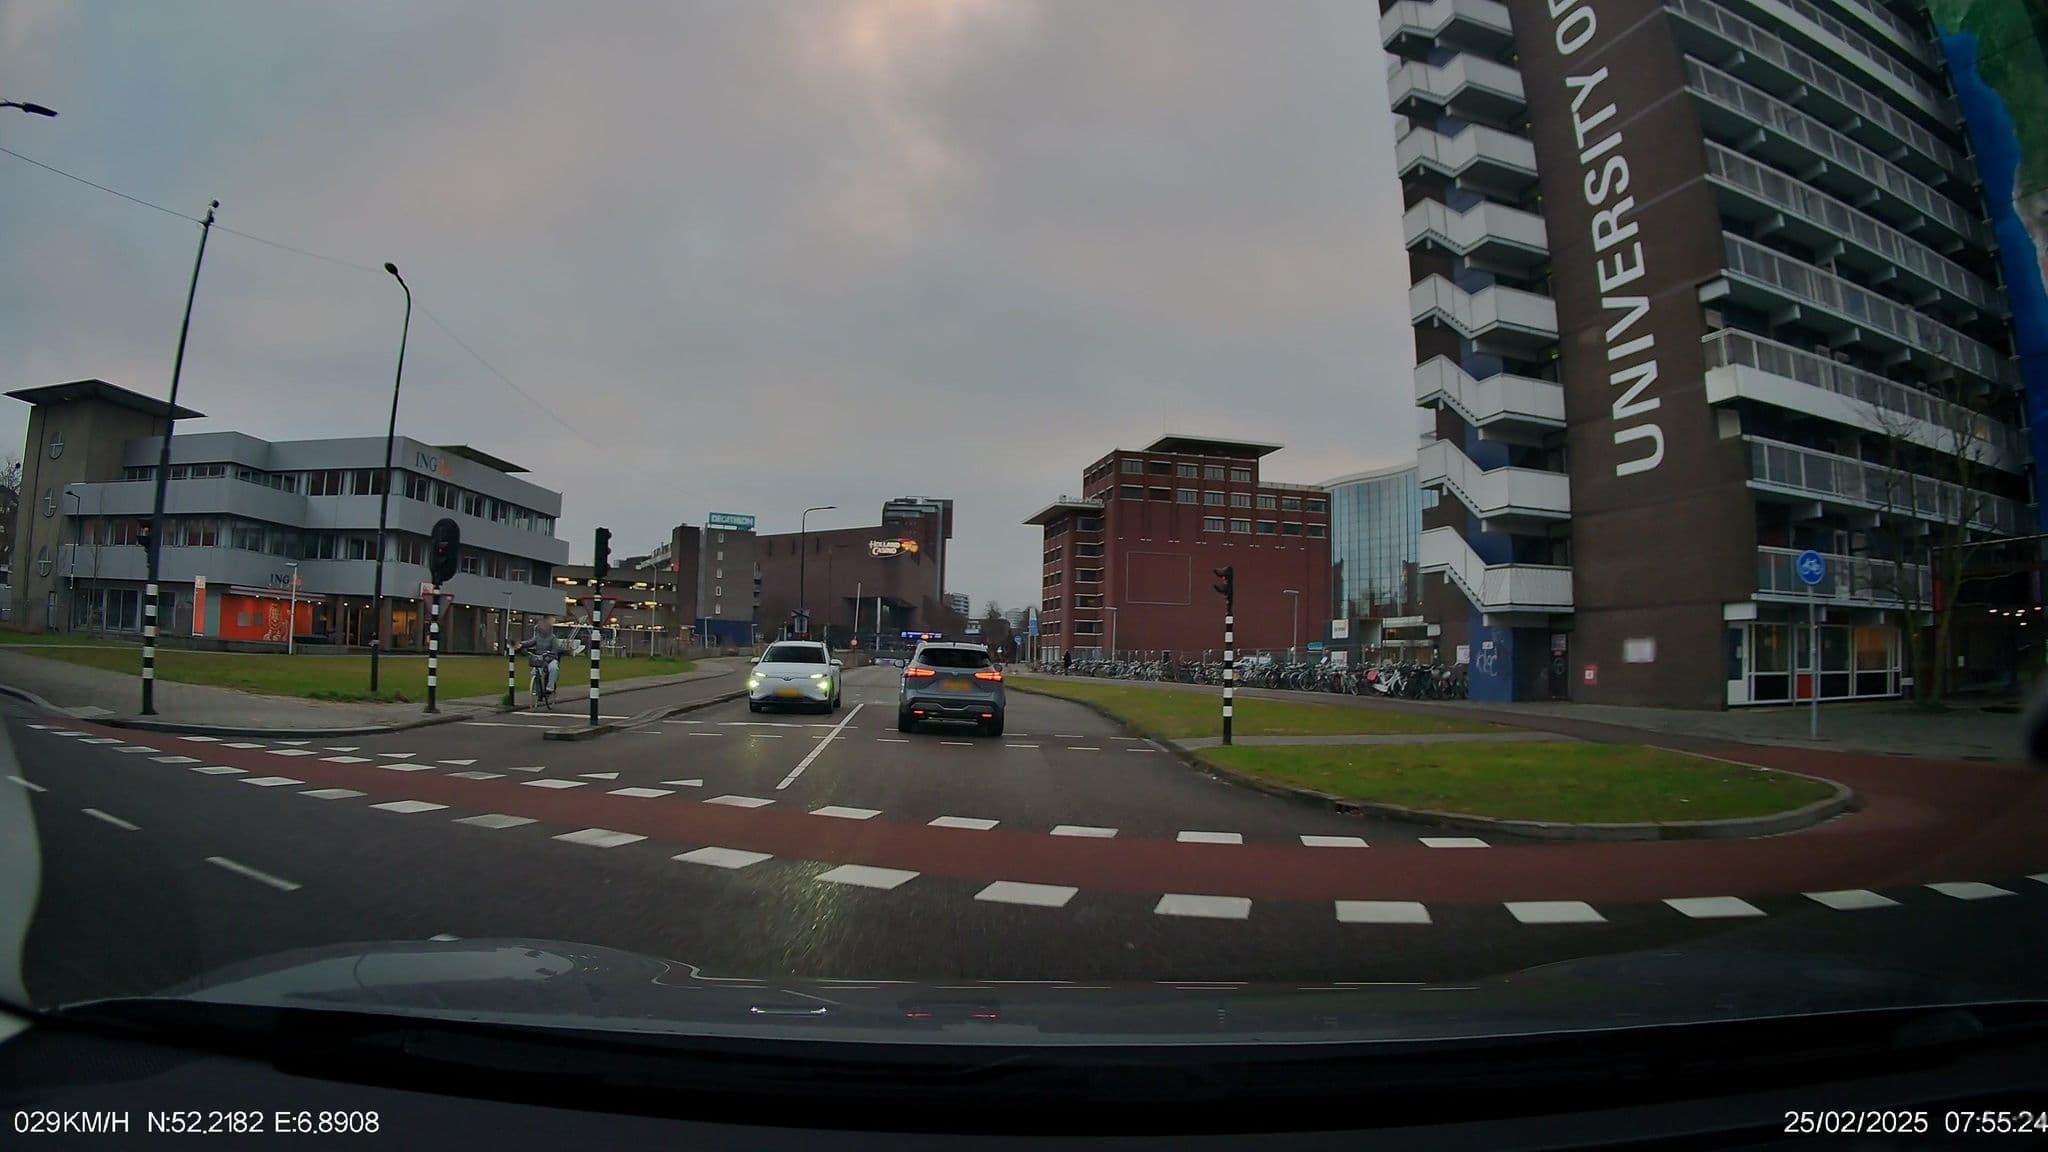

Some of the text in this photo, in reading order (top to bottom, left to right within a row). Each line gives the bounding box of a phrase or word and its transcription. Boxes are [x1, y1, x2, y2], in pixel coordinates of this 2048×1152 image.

[1565, 66, 1665, 477] UNIVERSITY
[416, 451, 437, 472] ING
[270, 573, 290, 585] ING
